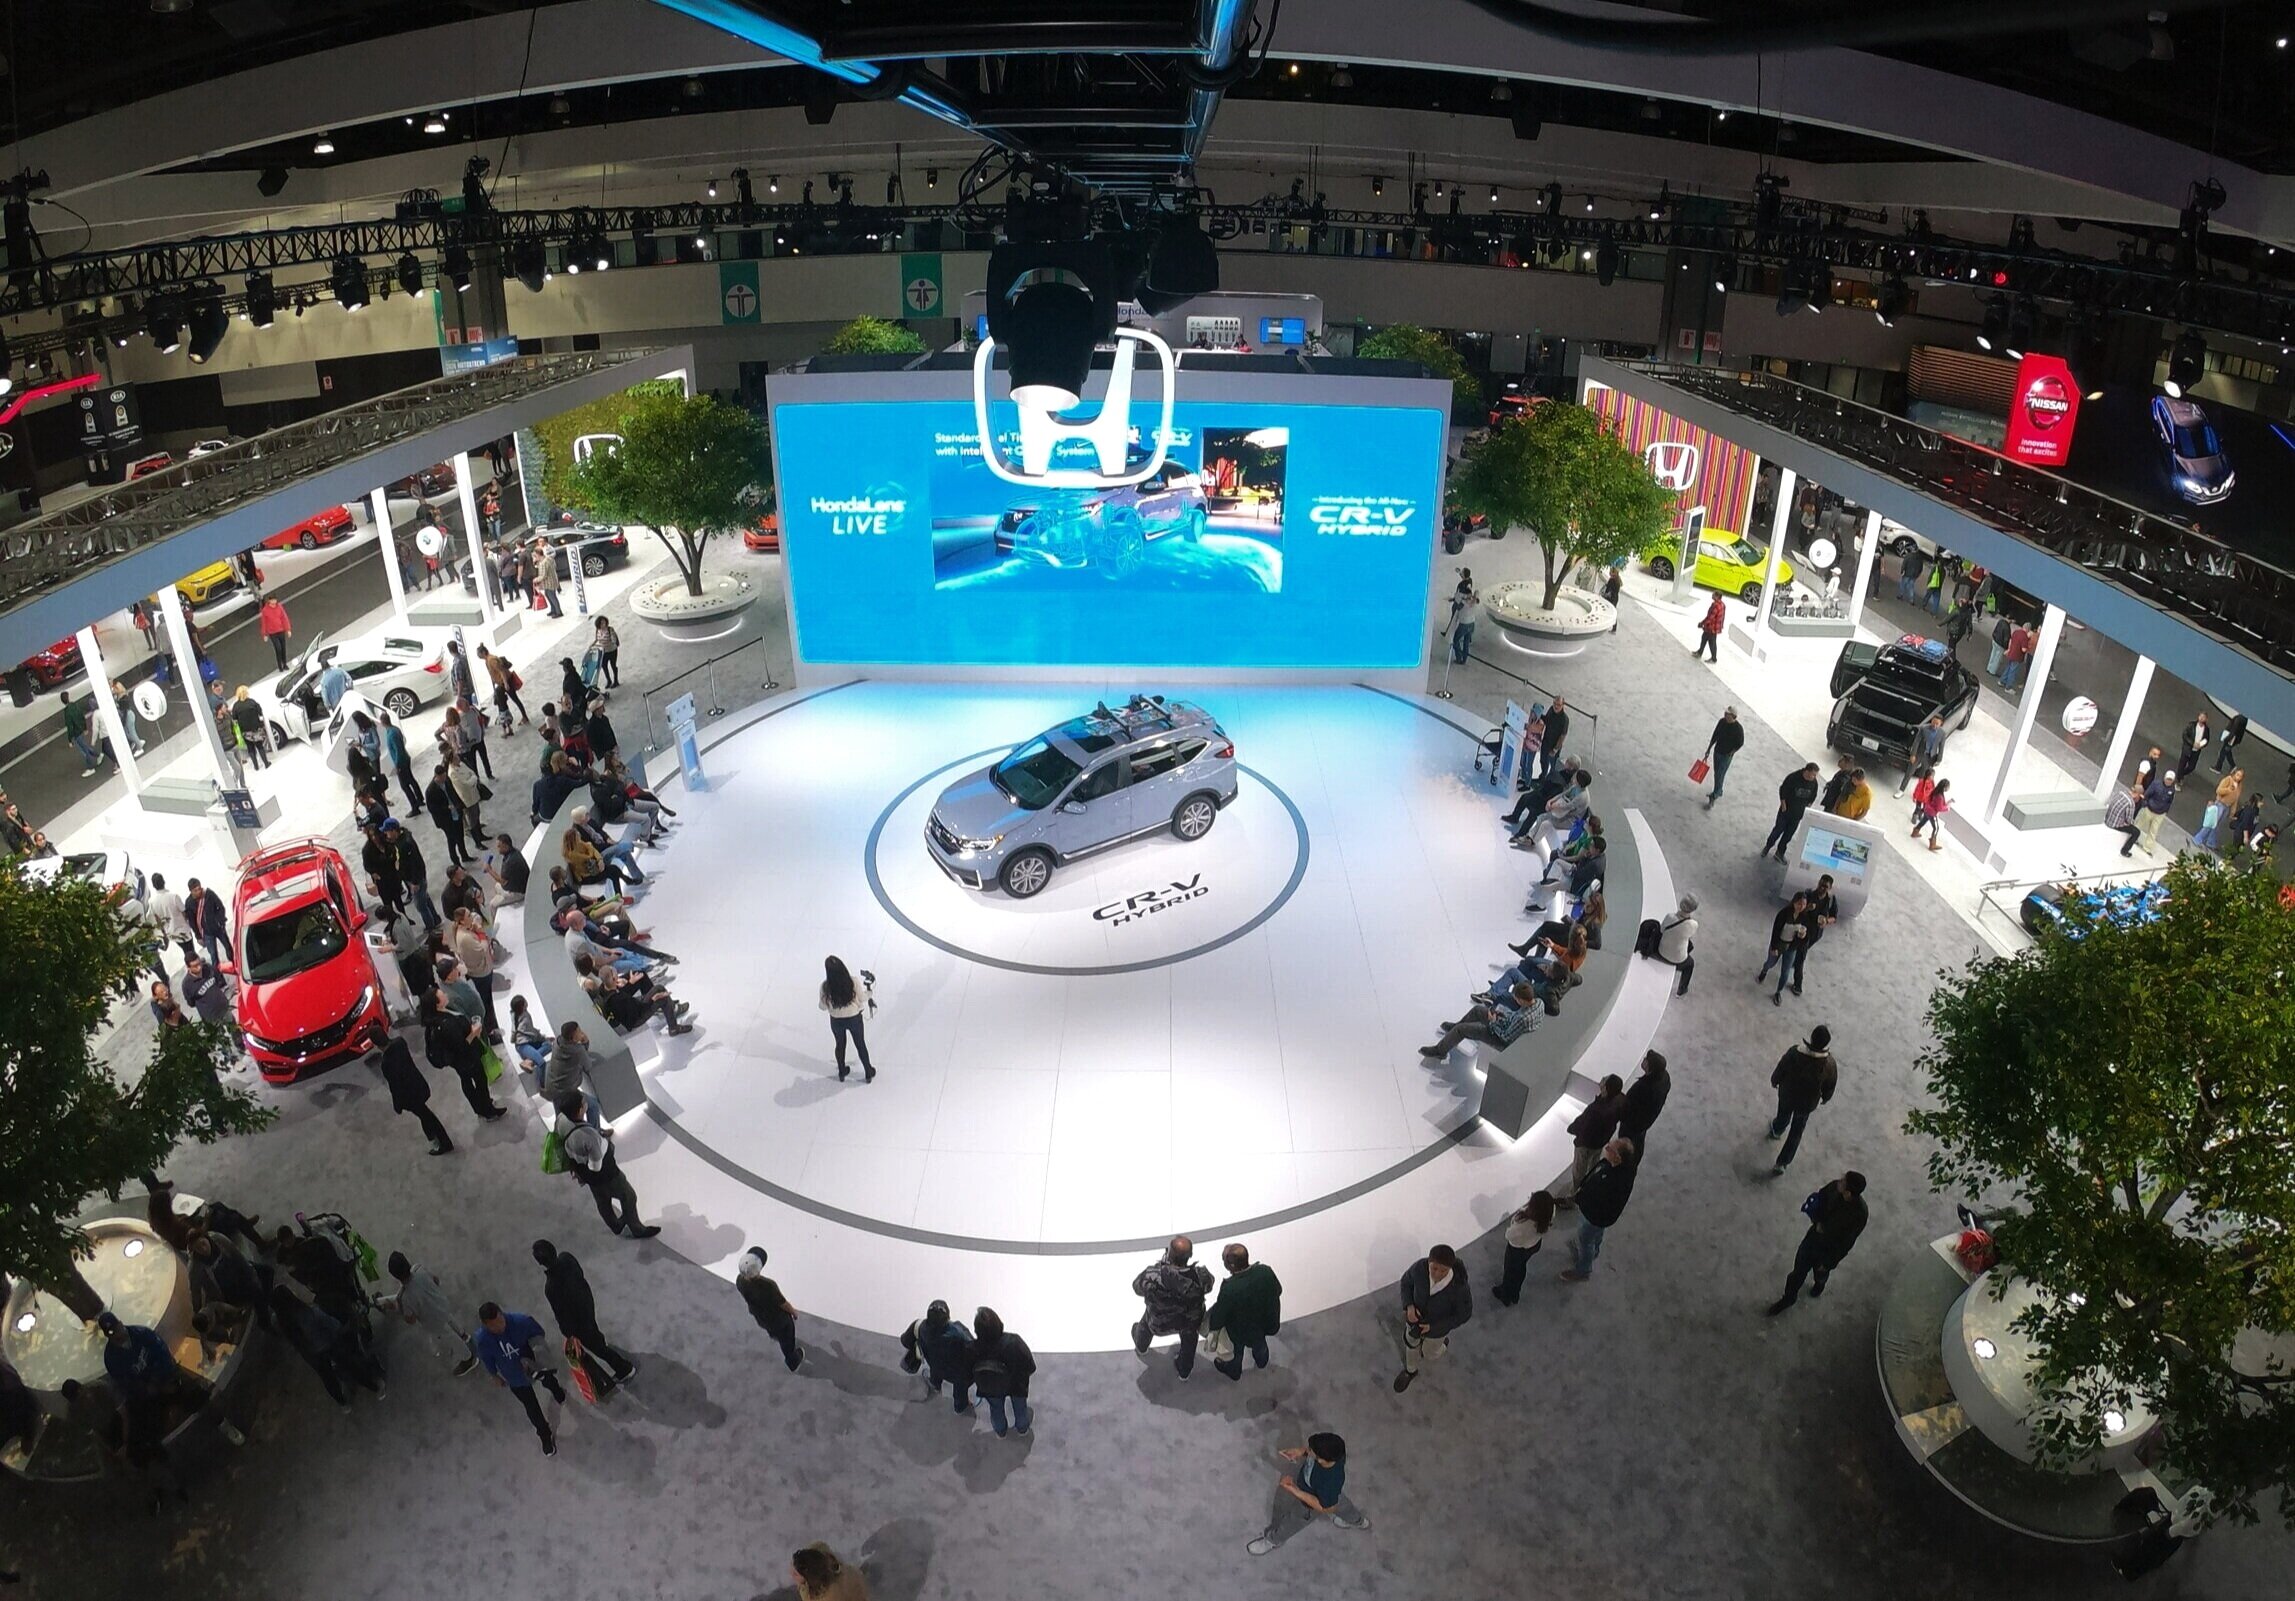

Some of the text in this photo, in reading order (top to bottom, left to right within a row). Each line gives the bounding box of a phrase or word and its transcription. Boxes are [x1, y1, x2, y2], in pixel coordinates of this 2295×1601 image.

[2031, 399, 2068, 412] NISSAN
[935, 445, 959, 457] with
[832, 514, 888, 535] LIVE
[1309, 505, 1416, 525] CR-V
[1317, 523, 1407, 536] HYBRID
[571, 551, 585, 604] HYBRID
[1092, 872, 1201, 921] CR-V
[1113, 886, 1209, 927] HYBRID
[499, 1340, 520, 1360] LA
